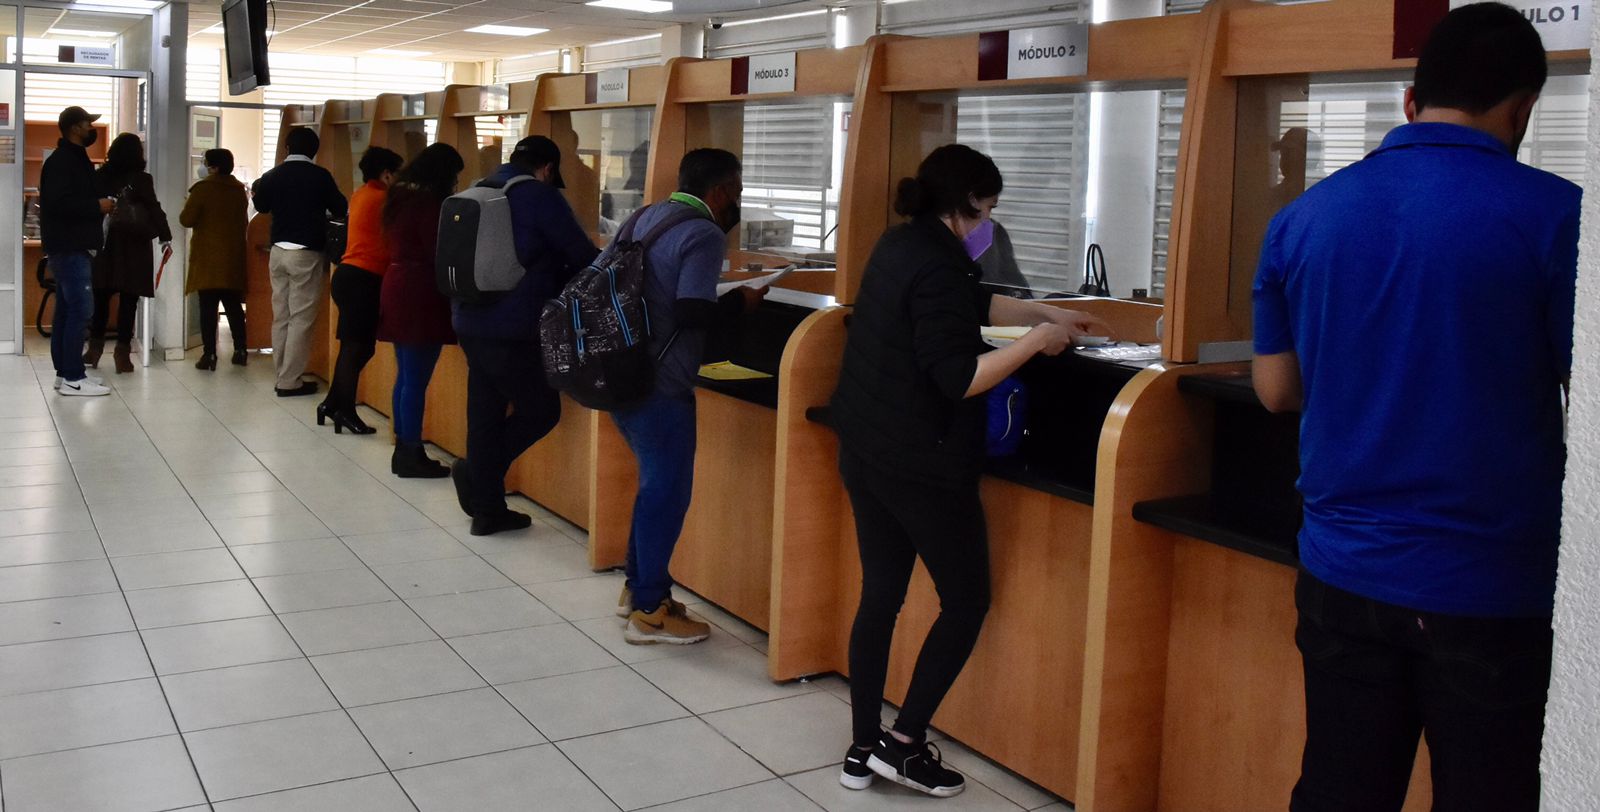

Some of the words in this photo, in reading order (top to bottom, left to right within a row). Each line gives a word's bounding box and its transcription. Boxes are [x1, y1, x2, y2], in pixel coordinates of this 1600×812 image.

[1521, 6, 1565, 23] ULO
[1571, 5, 1579, 21] 1
[1018, 45, 1066, 60] MÓDULO
[1068, 45, 1076, 57] 2
[755, 68, 783, 80] MÓDULO
[784, 68, 789, 78] 3
[601, 82, 620, 92] MÓDULO
